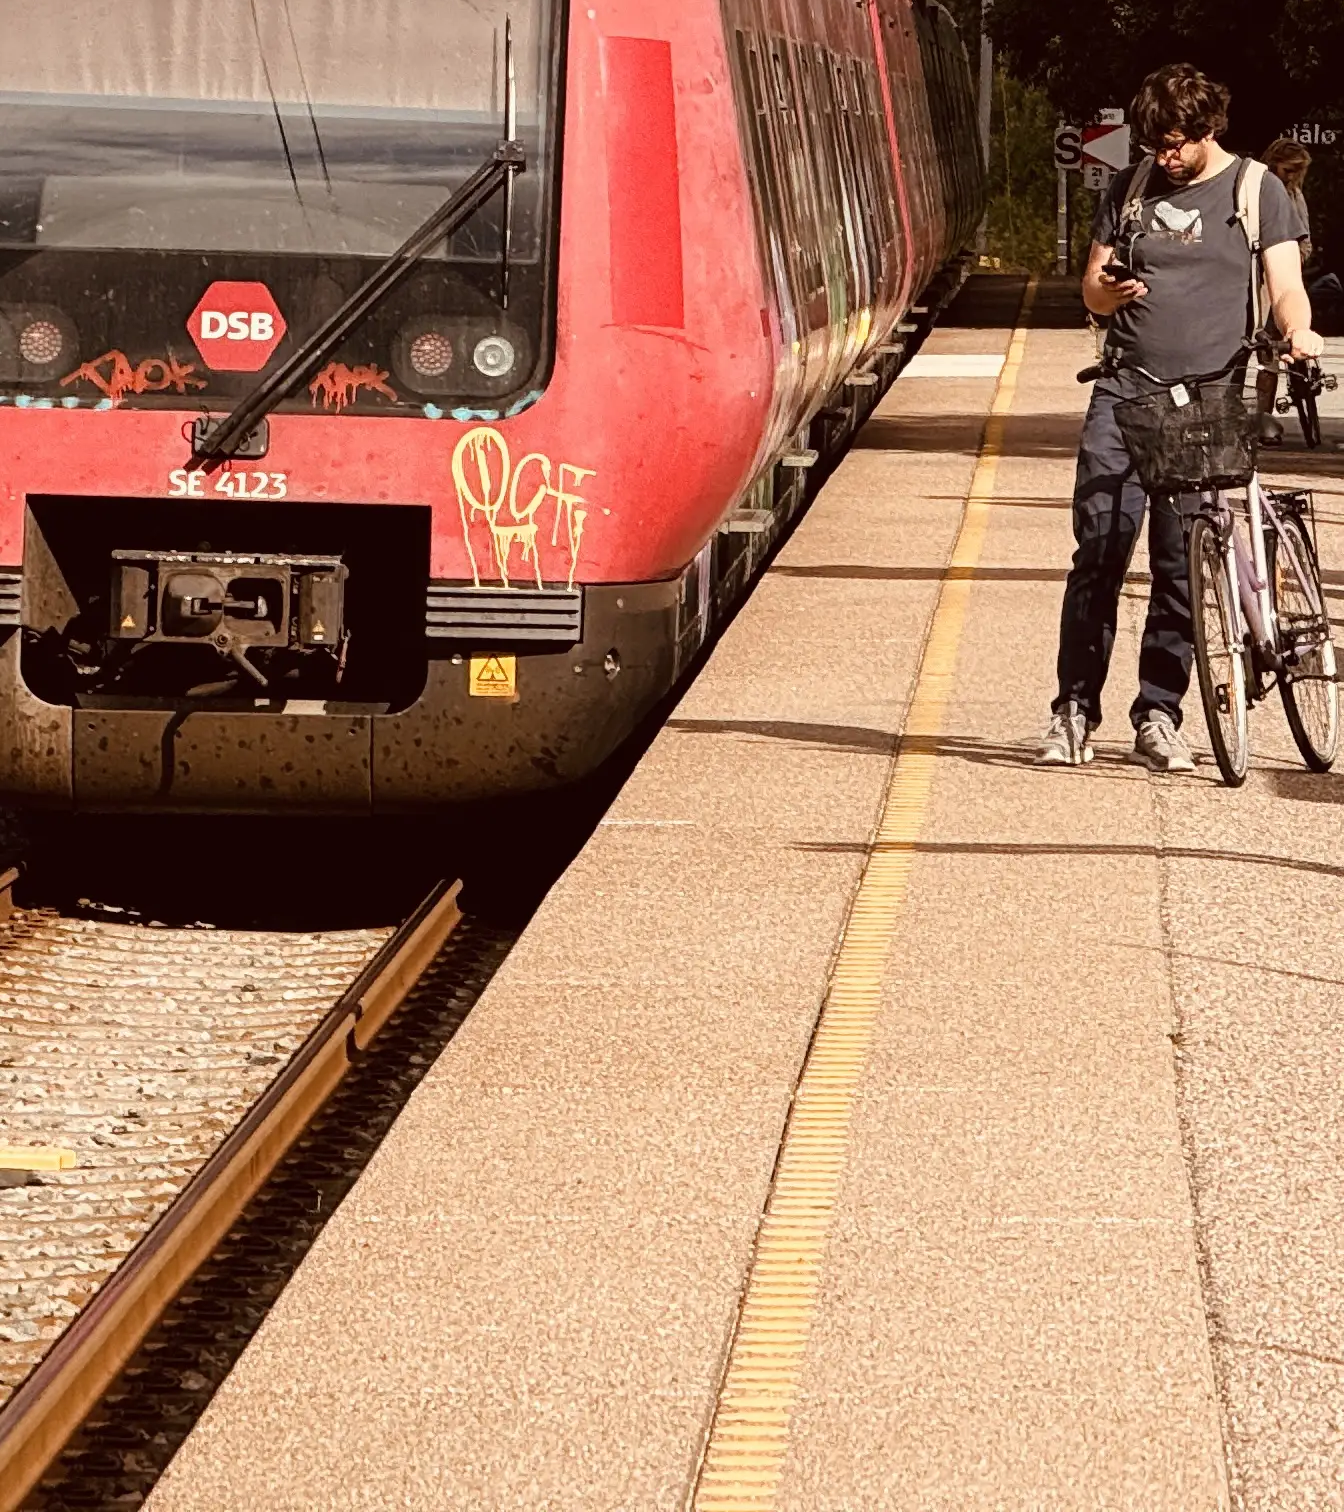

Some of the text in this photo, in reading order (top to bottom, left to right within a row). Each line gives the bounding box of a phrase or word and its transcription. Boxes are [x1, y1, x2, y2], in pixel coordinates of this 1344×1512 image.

[1055, 132, 1081, 164] S
[200, 311, 274, 340] DSB
[168, 469, 287, 499] SE 4123
